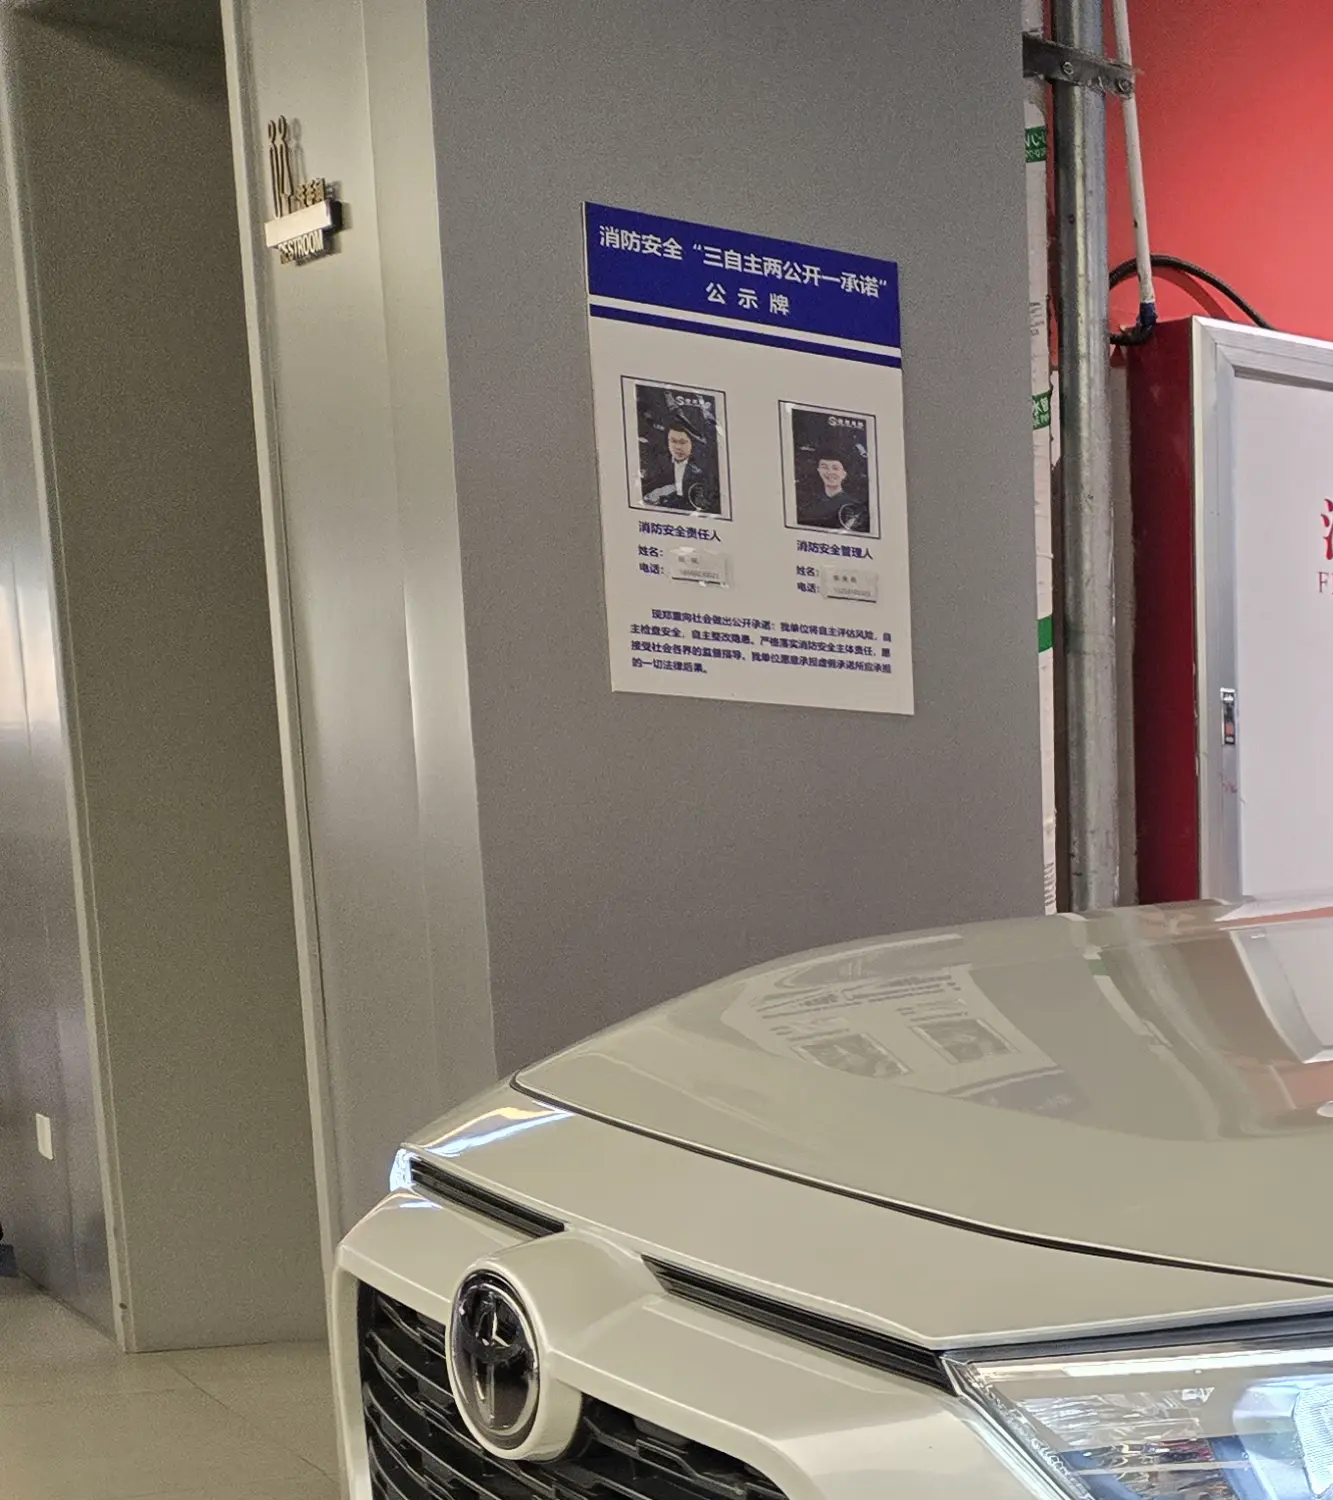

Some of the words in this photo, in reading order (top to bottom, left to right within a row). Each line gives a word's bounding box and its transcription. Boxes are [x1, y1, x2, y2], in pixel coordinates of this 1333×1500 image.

[705, 281, 791, 317] 公示牌
[638, 520, 722, 543] 消防安全责任人
[796, 539, 874, 561] 消防安全管理人
